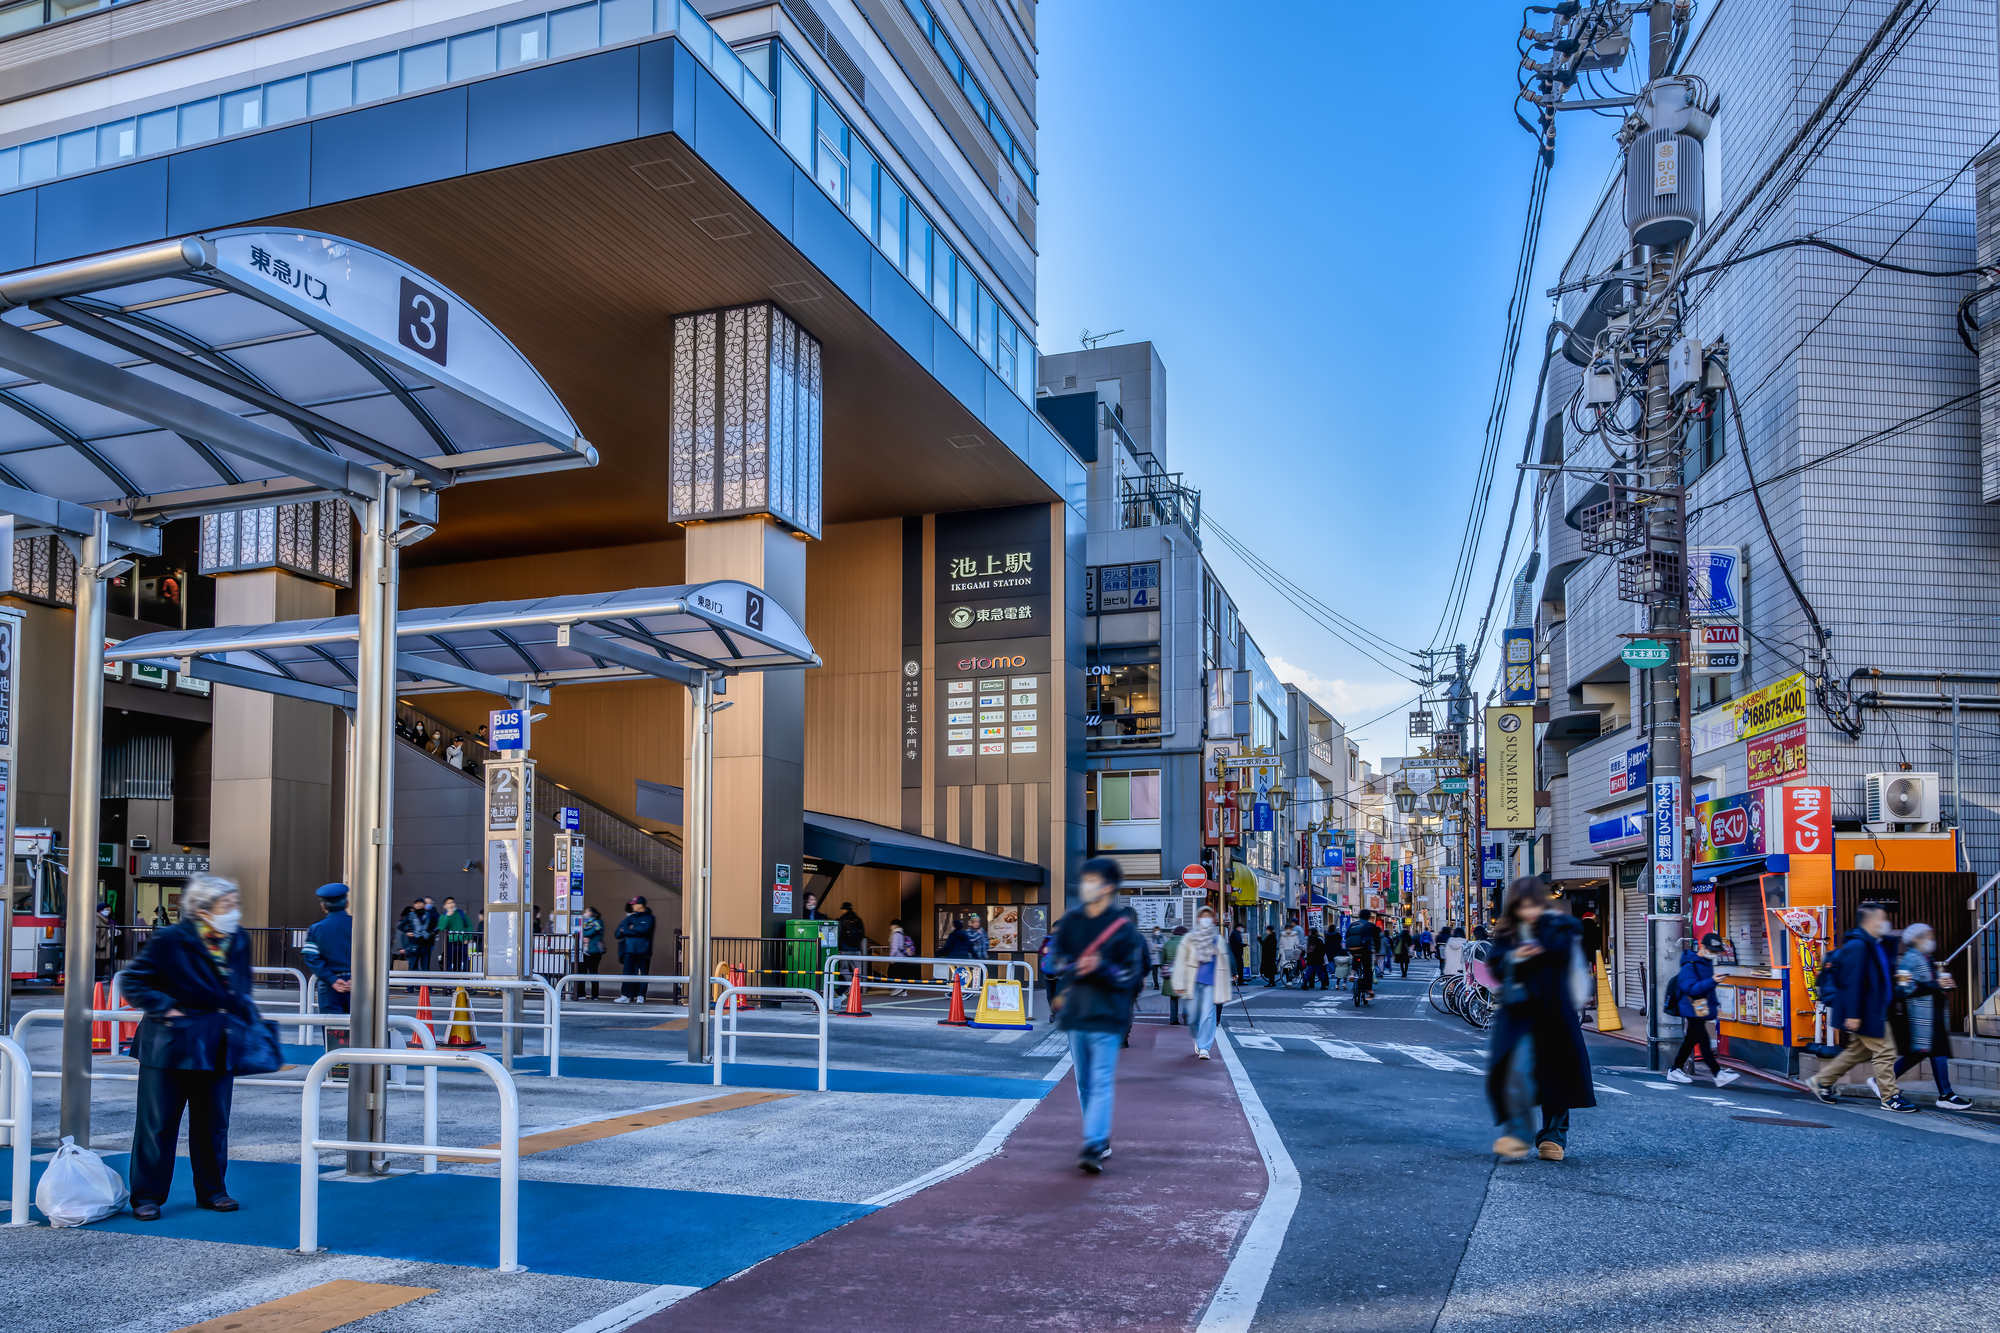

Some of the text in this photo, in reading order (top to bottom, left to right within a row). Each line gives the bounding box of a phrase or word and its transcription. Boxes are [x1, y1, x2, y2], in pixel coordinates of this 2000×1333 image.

[1657, 160, 1675, 172] 50
[1656, 175, 1676, 188] 125
[249, 244, 331, 307] 東急バス
[410, 293, 437, 350] 3
[949, 551, 1034, 579] 池上駅
[1687, 556, 1729, 568] AWSON
[1103, 564, 1157, 579] 労災交通事故
[950, 577, 1032, 592] IKEGAMI STATION
[697, 594, 724, 616] 東急バス
[1103, 596, 1127, 606] 当ビル
[749, 596, 760, 626] 2
[976, 605, 1033, 623] 東急電鉄
[1703, 628, 1737, 641] ATM
[1623, 650, 1667, 658] 池上本通り会
[1690, 654, 1737, 666] CHI café
[957, 655, 1027, 671] etomo
[1086, 665, 1111, 676] LON
[1507, 638, 1533, 691] 歯科
[493, 712, 519, 726] BUS
[906, 703, 918, 760] 池上本門寺
[982, 745, 1002, 753] 宝くじ
[1407, 759, 1455, 767] 池上駅前通り
[1774, 743, 1807, 776] 3億円
[496, 769, 512, 793] 2
[1505, 736, 1519, 823] SUNMERRY'S
[1628, 772, 1637, 786] 2F
[490, 805, 518, 818] 池上駅前
[567, 809, 579, 817] BUS
[1657, 784, 1672, 860] あさひろ眼科
[1792, 788, 1821, 852] 宝くじ
[1713, 814, 1744, 842] 宝くじ
[149, 861, 209, 871] 池上駅前交
[498, 852, 509, 901] 徳持小学校
